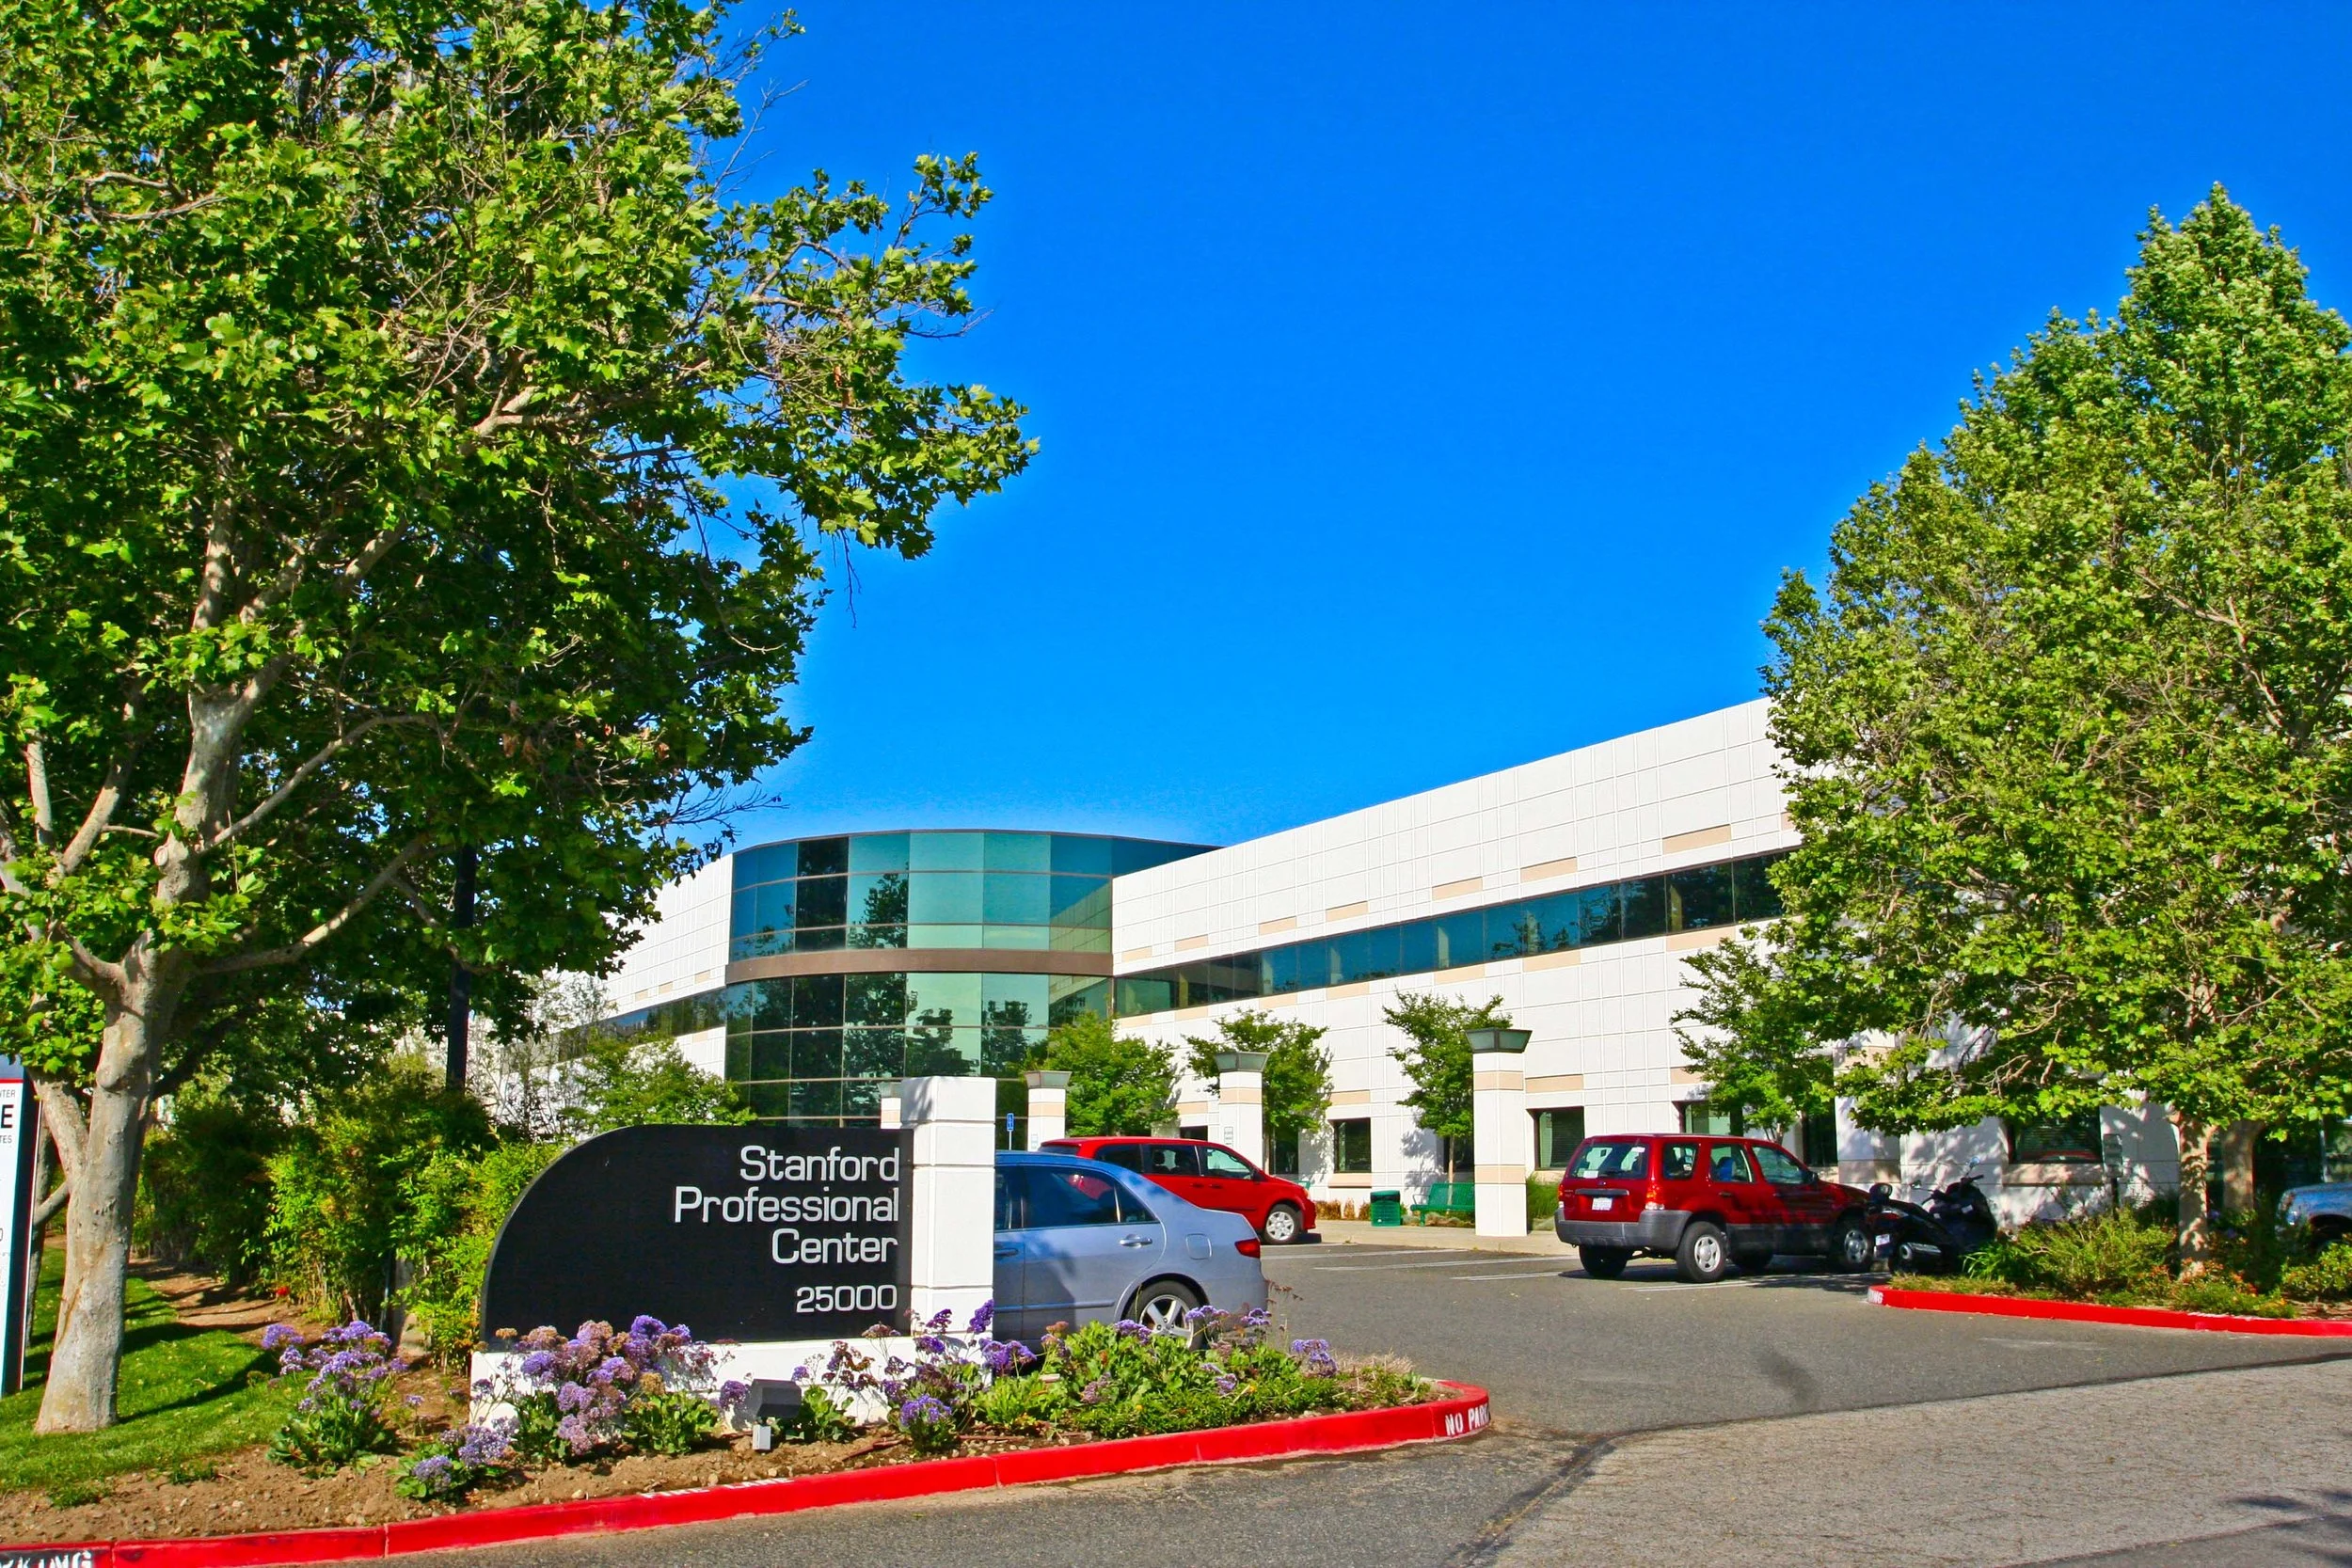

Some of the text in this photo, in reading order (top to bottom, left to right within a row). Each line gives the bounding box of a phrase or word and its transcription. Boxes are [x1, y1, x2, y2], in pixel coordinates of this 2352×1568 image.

[740, 1145, 899, 1181] Stanford
[675, 1186, 898, 1223] Professional
[771, 1227, 898, 1264] Center
[796, 1284, 898, 1313] 25000
[1445, 1413, 1464, 1436] NO
